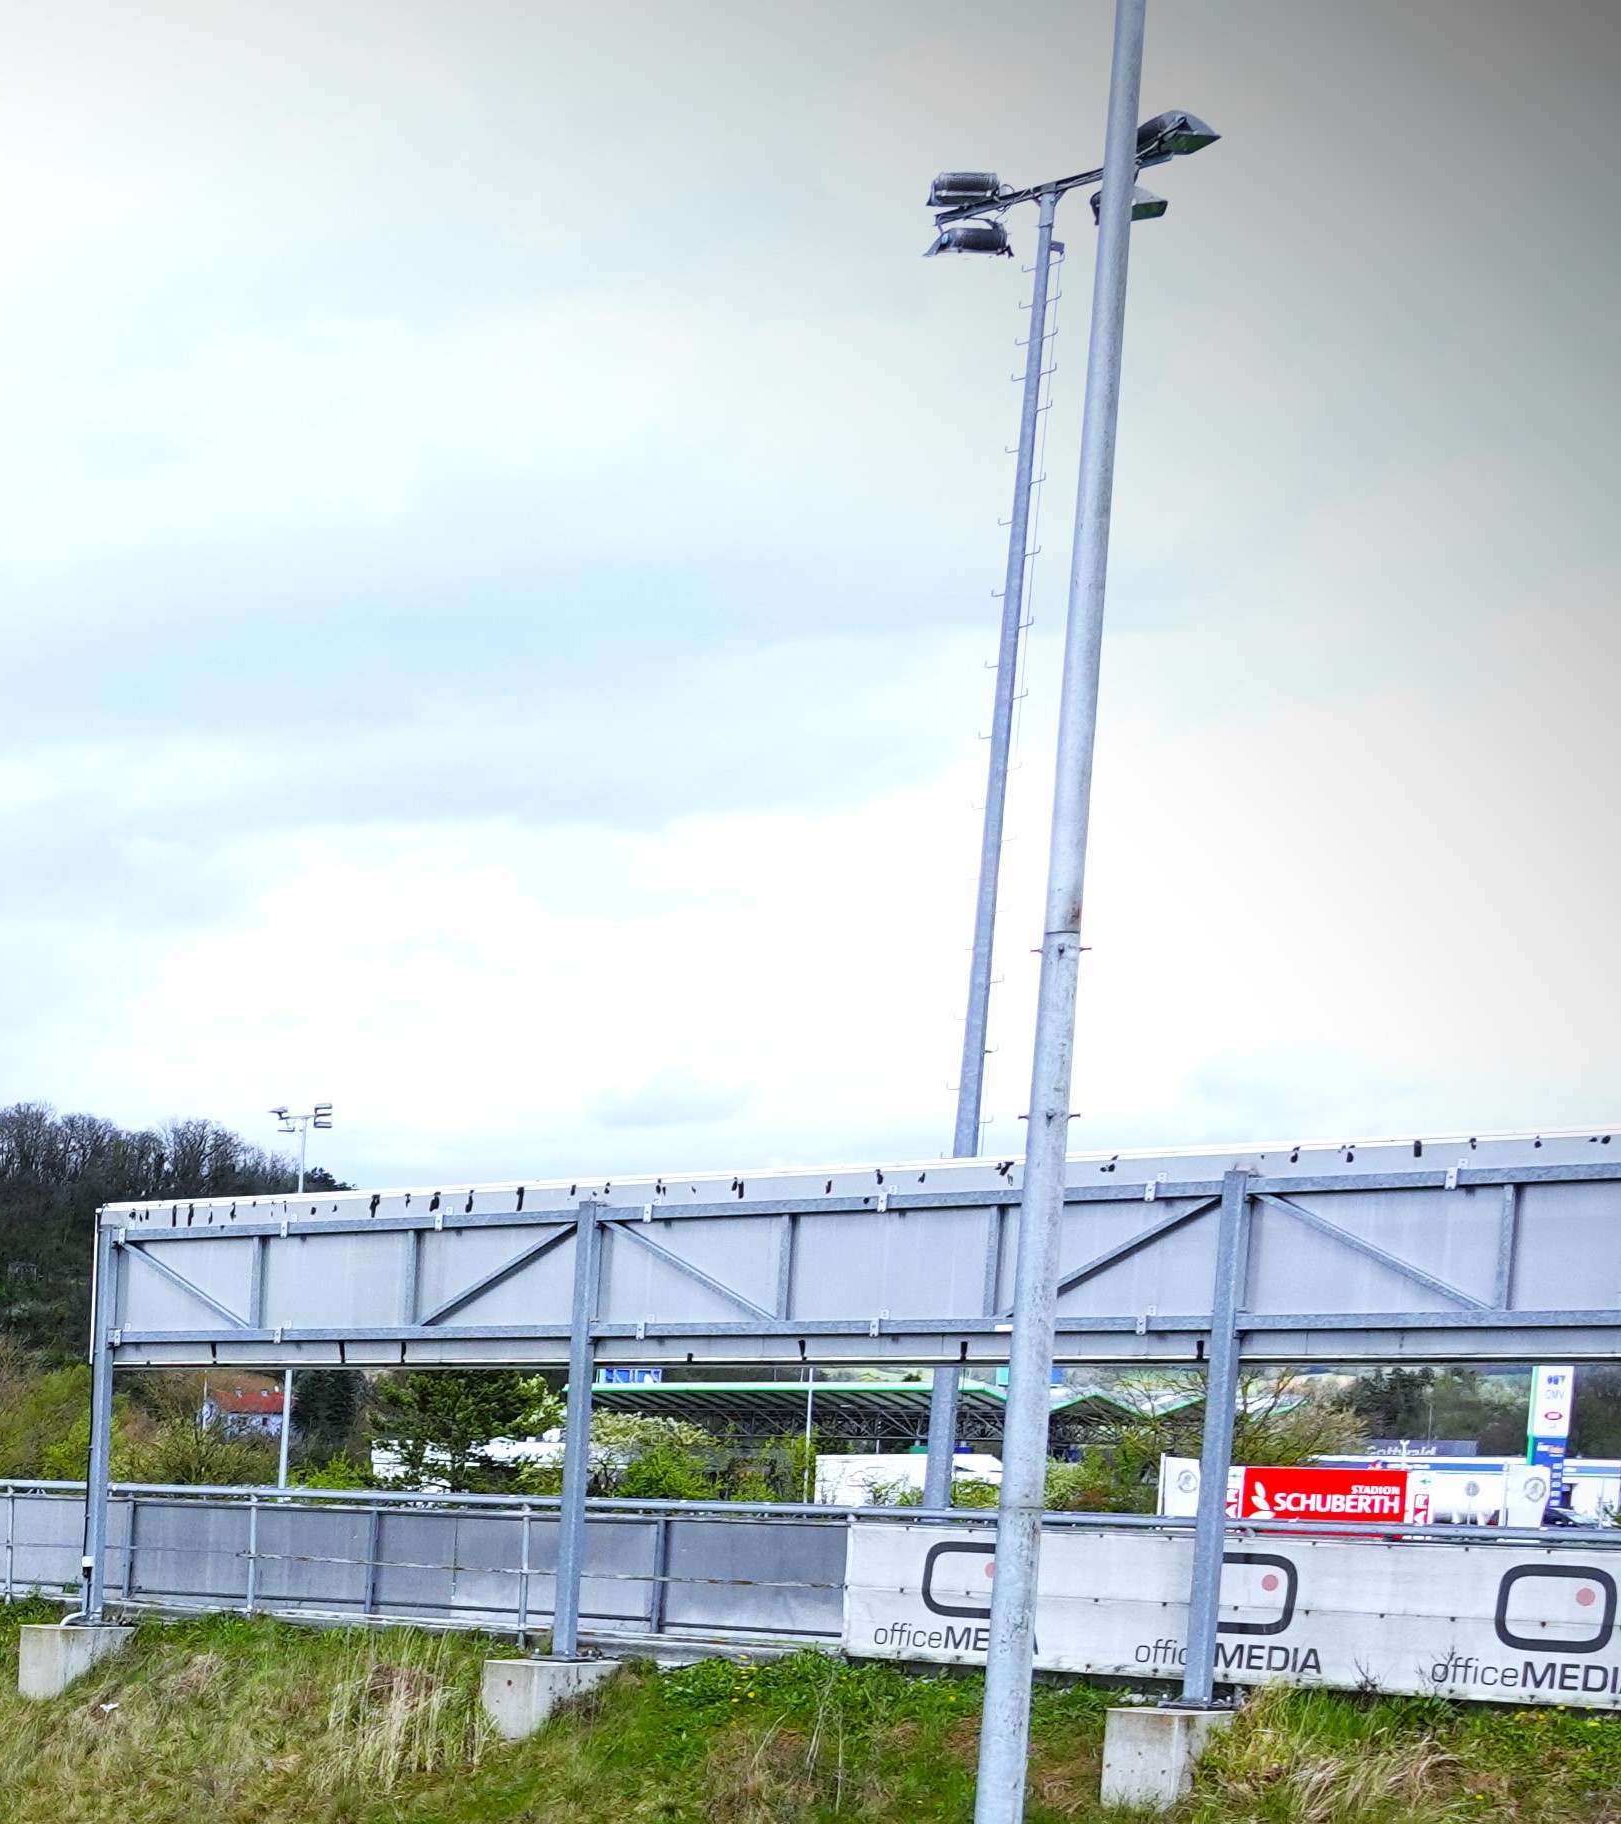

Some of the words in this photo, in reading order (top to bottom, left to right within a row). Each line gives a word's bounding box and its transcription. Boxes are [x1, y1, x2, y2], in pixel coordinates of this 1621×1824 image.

[1273, 1492, 1400, 1514] SCHUBERTH
[1351, 1484, 1400, 1496] STADION
[1134, 1638, 1323, 1675] officMEDIA
[1431, 1654, 1621, 1694] officeMEDI
